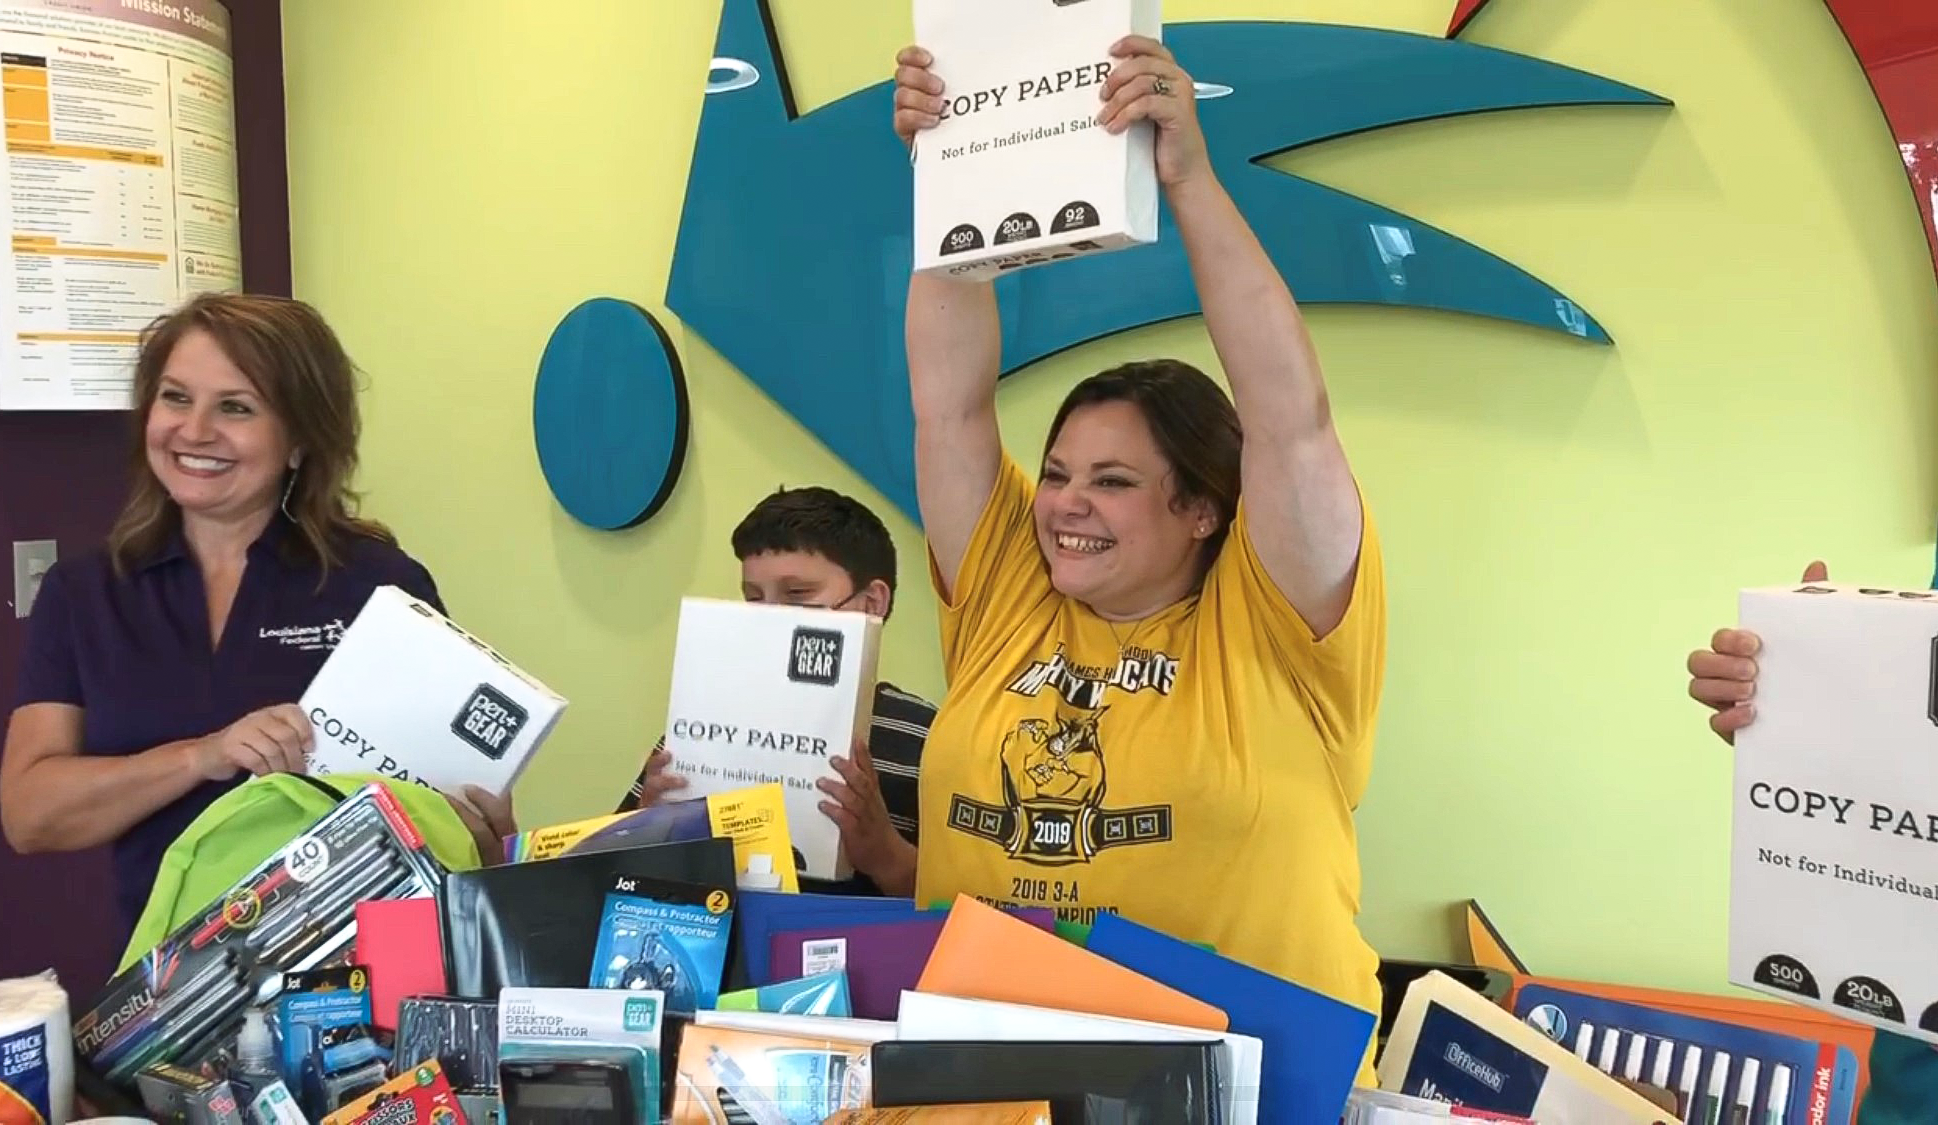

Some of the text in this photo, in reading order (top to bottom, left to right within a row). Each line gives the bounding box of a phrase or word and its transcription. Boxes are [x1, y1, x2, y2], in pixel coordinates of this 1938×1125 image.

[120, 0, 181, 21] Mission
[939, 61, 1112, 121] COPY PAPER
[941, 115, 1102, 161] Not for Individual Sale
[1002, 217, 1034, 235] 20LB
[1064, 206, 1086, 223] 92
[950, 230, 975, 247] 500
[259, 625, 320, 638] Louisiana
[280, 633, 321, 645] Federal
[797, 652, 835, 678] GEAR
[309, 707, 377, 759] COPY
[465, 709, 508, 749] GEAR
[674, 718, 828, 757] COPY PAPER
[674, 756, 814, 791] Not for Individual Sale
[1749, 782, 1855, 825] COPY
[1033, 820, 1071, 845] 2019
[291, 840, 320, 869] 40
[615, 877, 636, 892] Jot
[1758, 847, 1938, 902] Not for Individual
[712, 893, 725, 907] 2
[1011, 877, 1079, 902] 2019 3-A
[615, 901, 721, 926] Compass & Protractor
[664, 924, 718, 939] rapporteur
[1769, 962, 1804, 985] 500
[1846, 981, 1894, 1008] 20LB
[506, 1005, 536, 1015] MINI
[506, 1015, 564, 1026] DESKTOP
[505, 1025, 589, 1037] CALCULATOR
[1447, 1042, 1502, 1089] OfficeHub
[1814, 1066, 1832, 1090] ink
